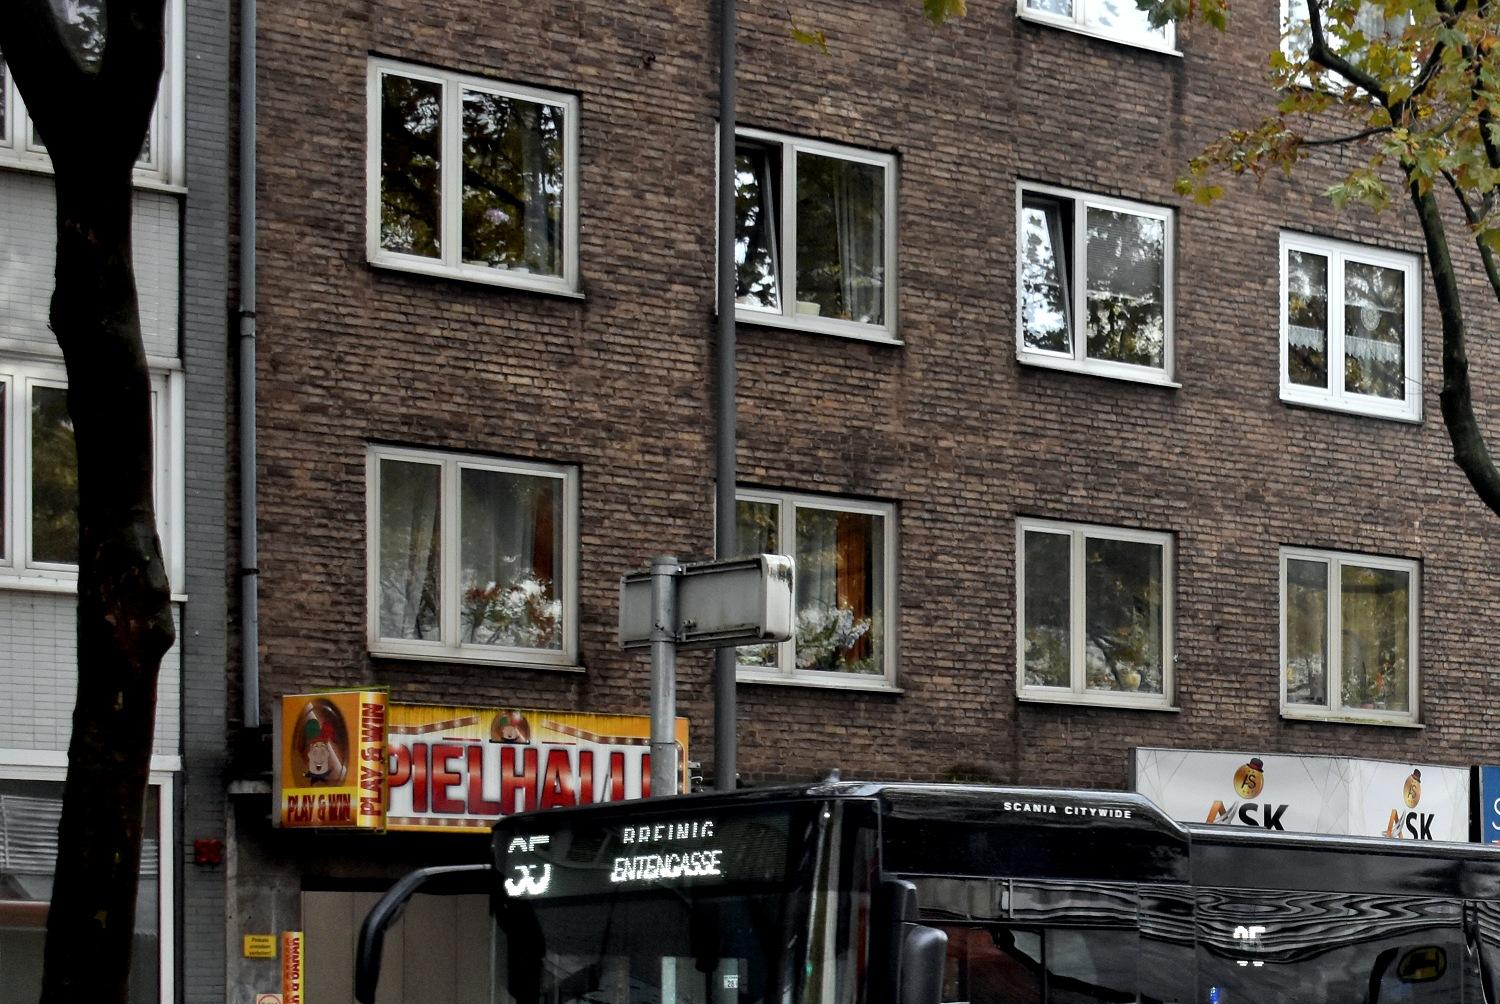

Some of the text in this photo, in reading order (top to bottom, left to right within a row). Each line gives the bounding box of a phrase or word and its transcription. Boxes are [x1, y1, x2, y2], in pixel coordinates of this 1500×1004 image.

[362, 703, 385, 742] WIN
[288, 794, 315, 821] PLAY
[328, 793, 351, 821] WIN
[361, 766, 384, 816] PLAY
[1003, 801, 1132, 819] SCANIA CITYWIDE
